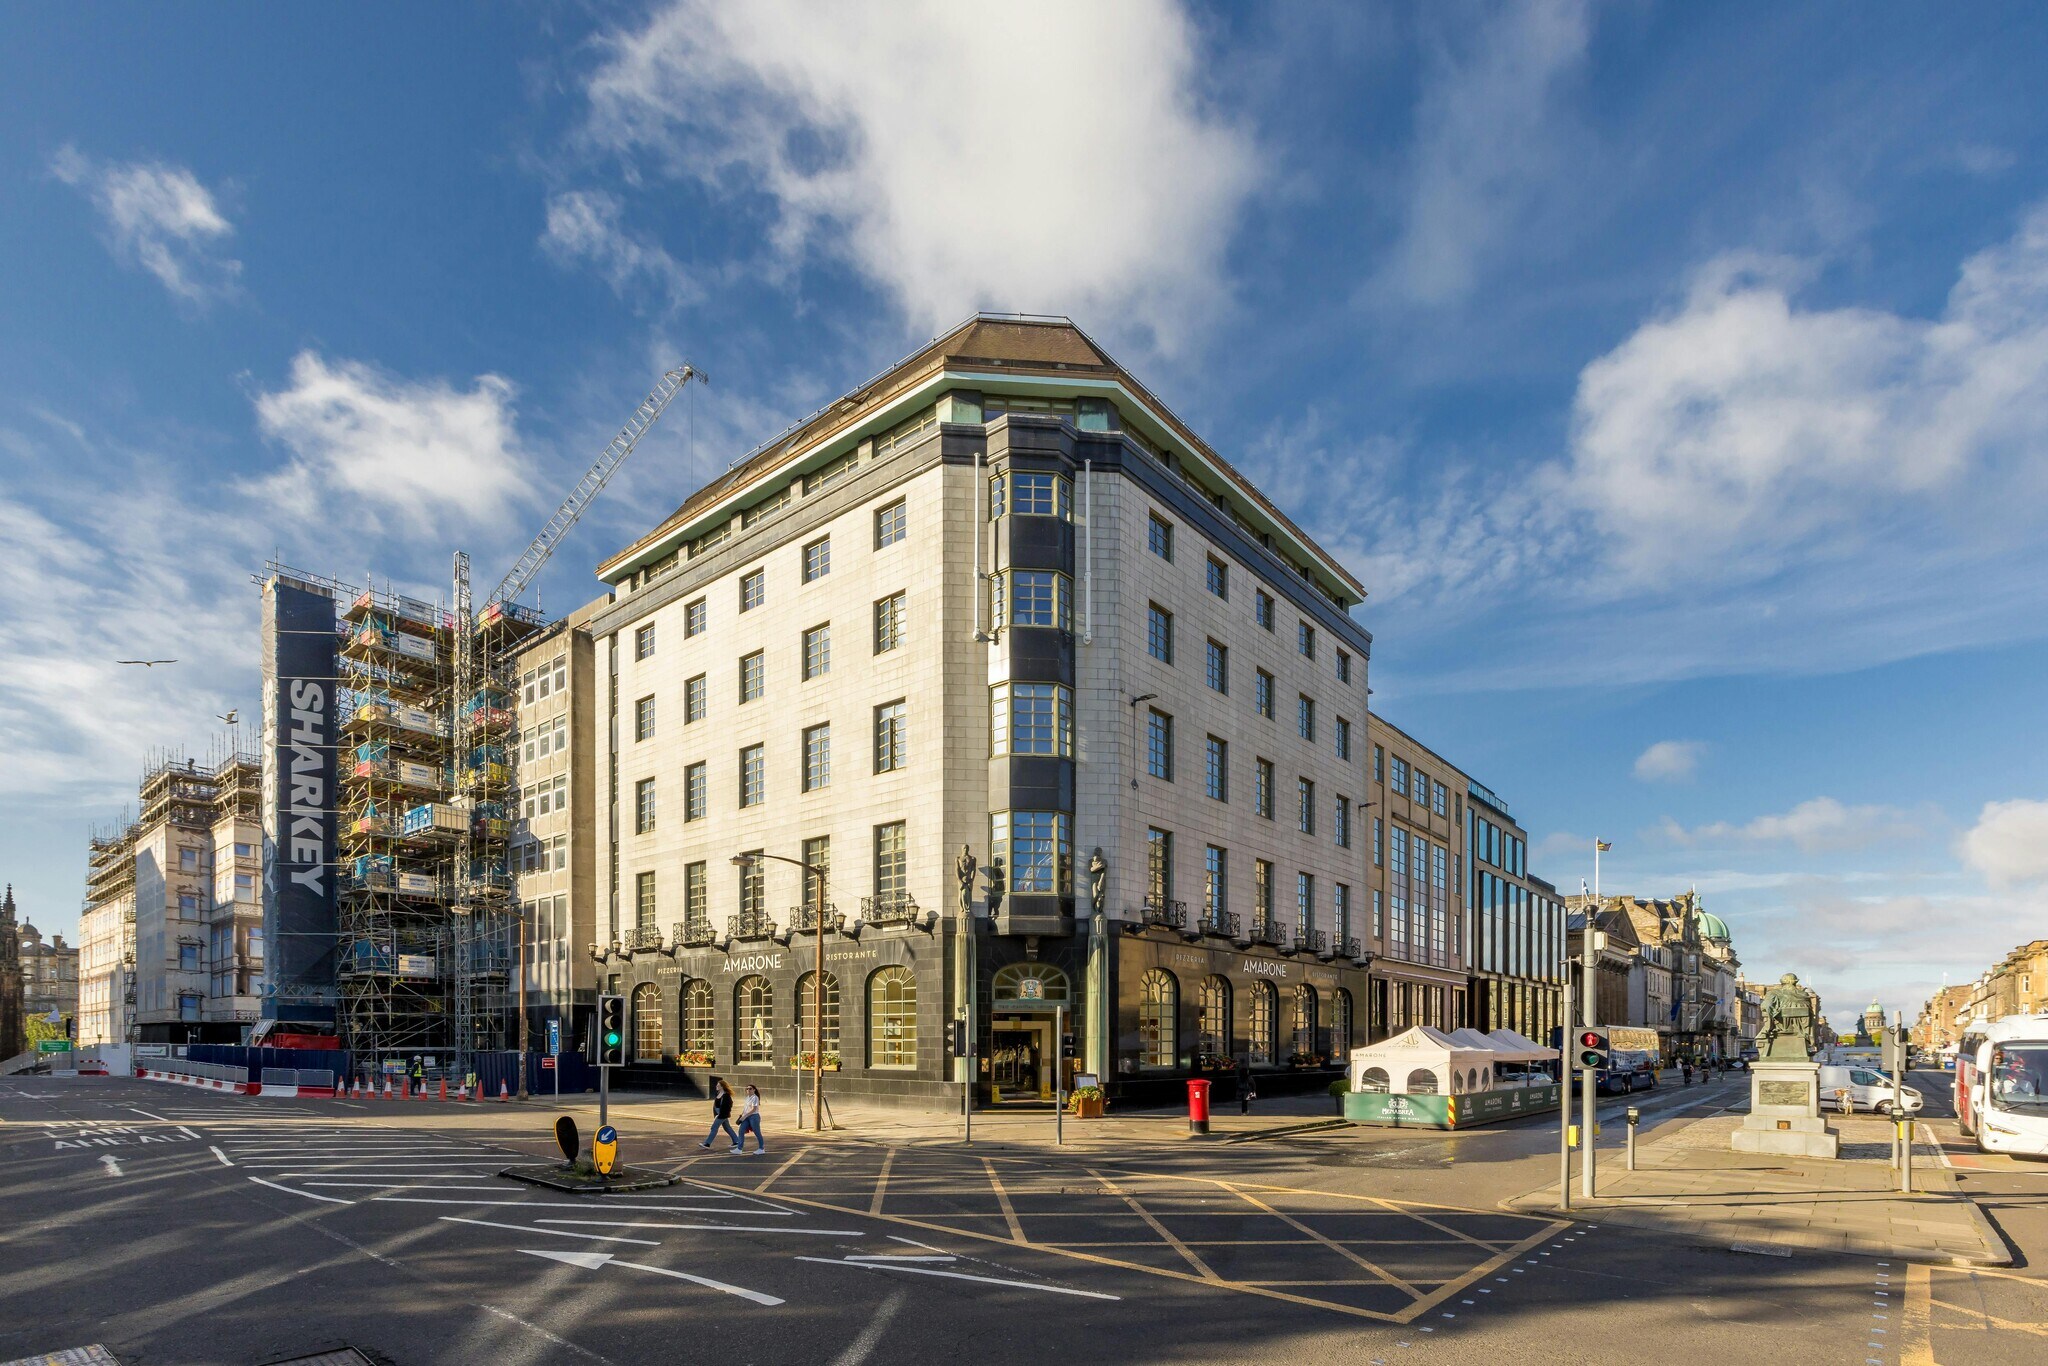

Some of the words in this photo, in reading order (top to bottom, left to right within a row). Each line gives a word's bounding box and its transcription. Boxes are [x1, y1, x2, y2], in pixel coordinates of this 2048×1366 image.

[290, 679, 324, 897] SHARKEY
[722, 954, 782, 972] AMARONE
[826, 950, 877, 960] RISTORANTE
[1242, 960, 1287, 977] AMARONE
[54, 1134, 192, 1150] AHEAD
